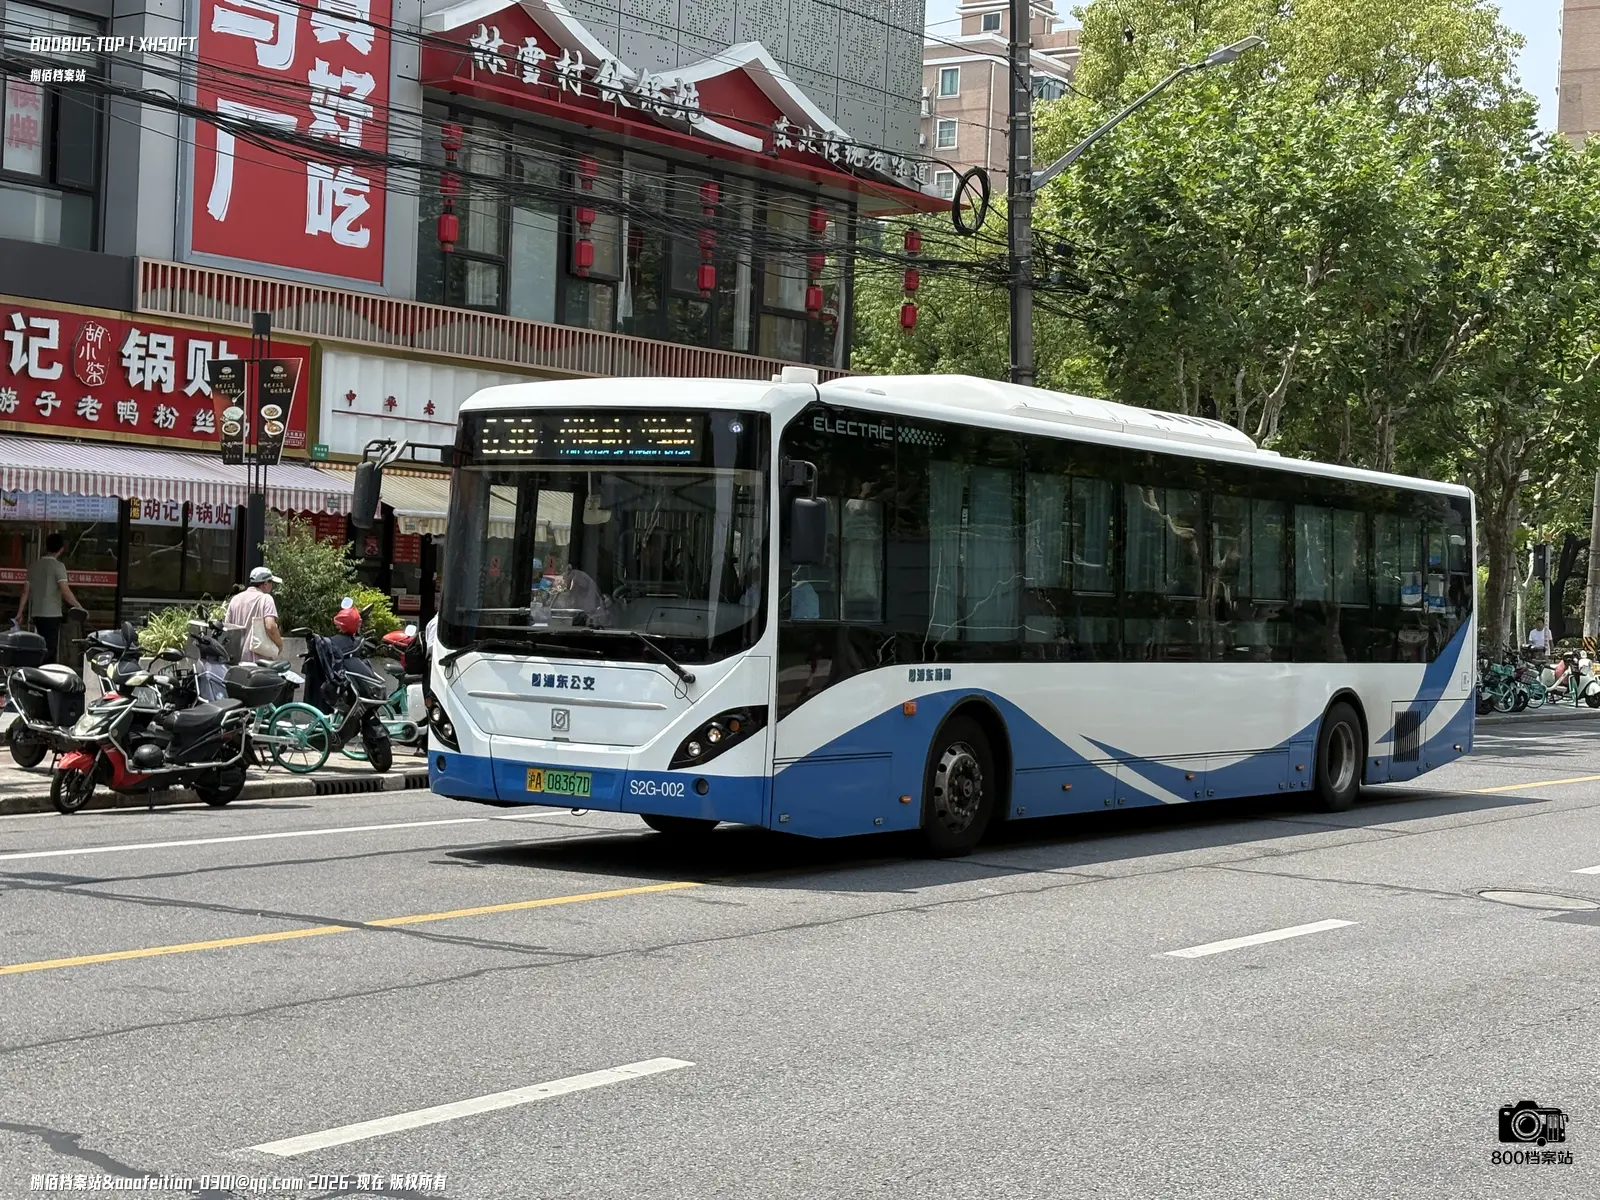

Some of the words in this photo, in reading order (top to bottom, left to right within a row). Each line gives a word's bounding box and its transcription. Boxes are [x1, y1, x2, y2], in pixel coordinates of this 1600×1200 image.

[774, 116, 932, 186] 东北传统老味道
[4, 312, 63, 380] 记
[813, 416, 894, 441] ELECTRIC
[195, 502, 233, 526] 锅贴
[542, 674, 596, 692] 浦东公交
[630, 779, 685, 798] S2G-002
